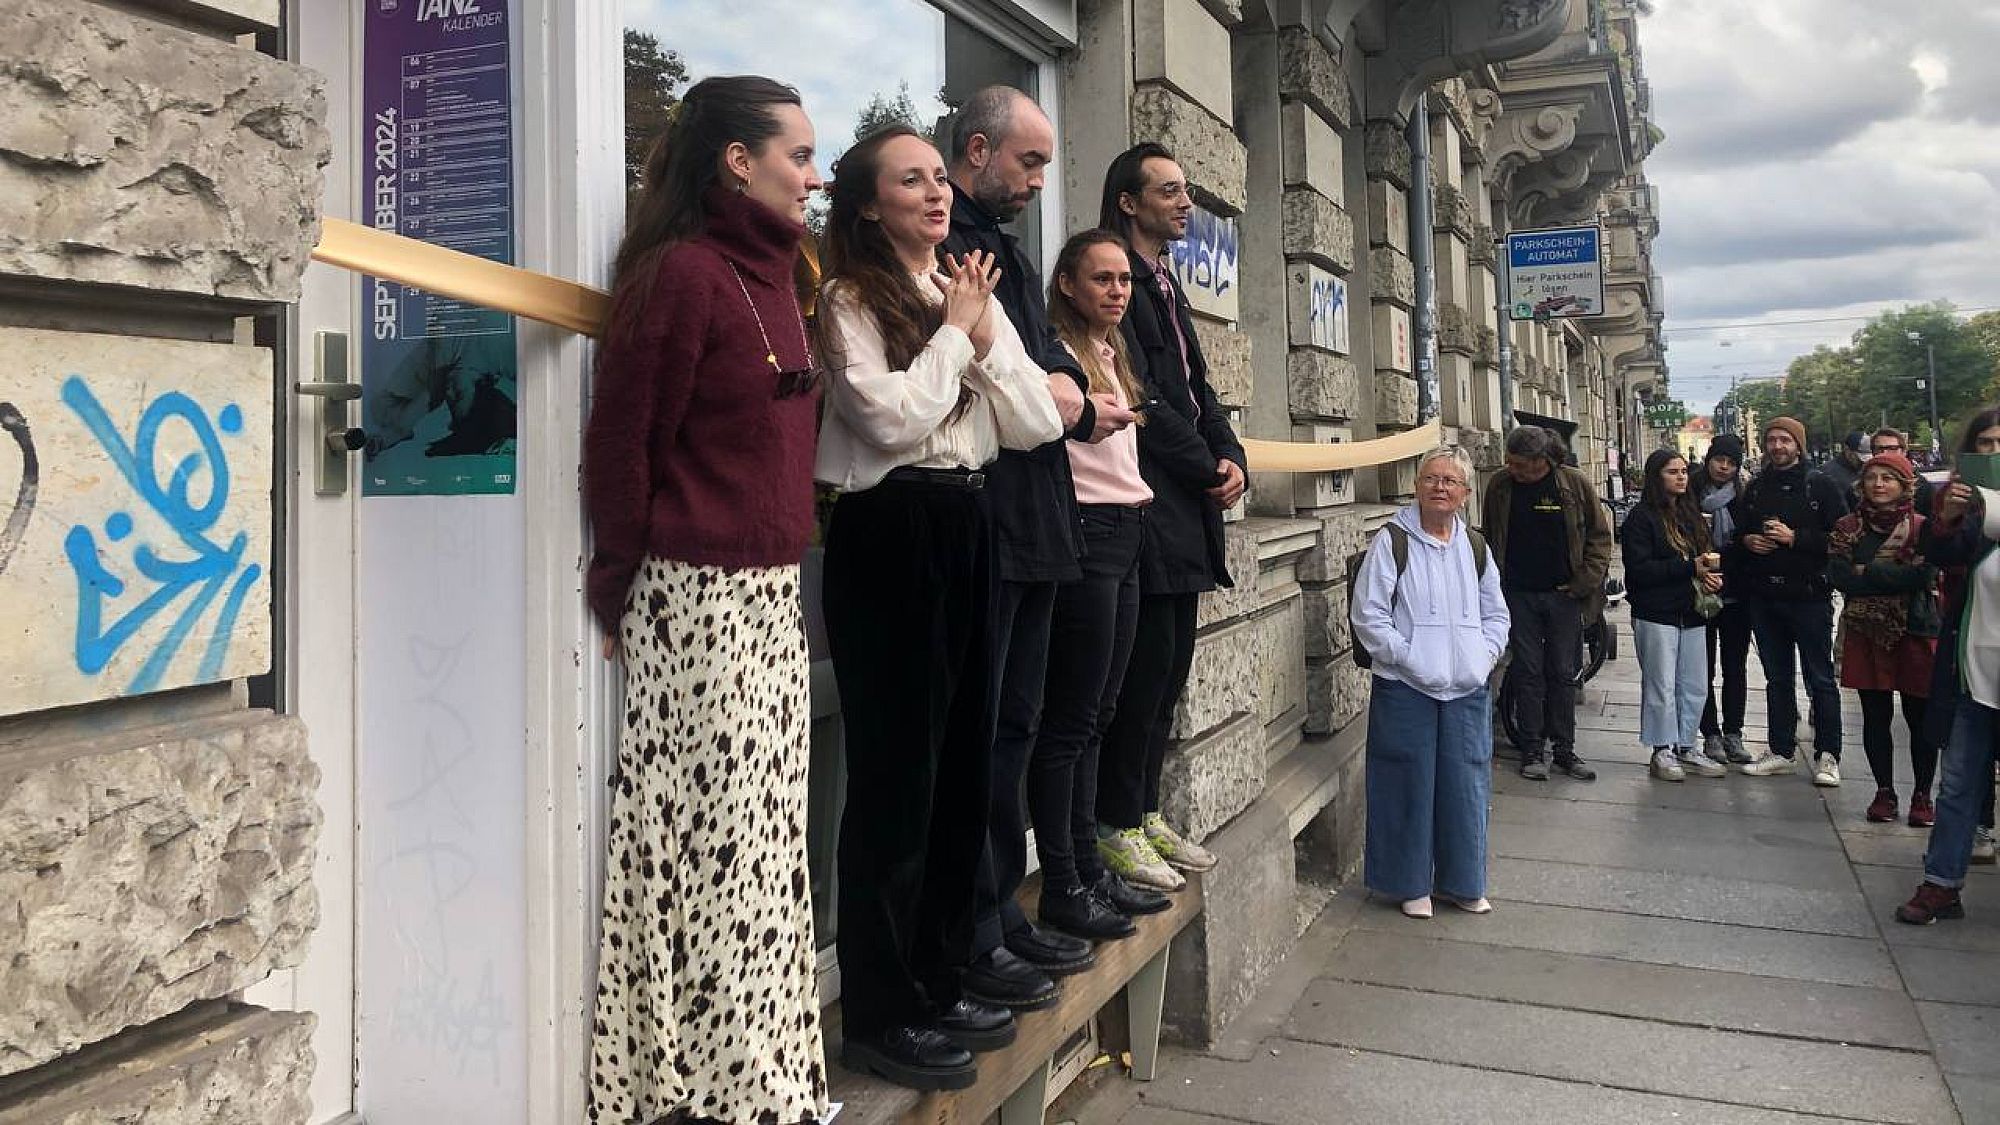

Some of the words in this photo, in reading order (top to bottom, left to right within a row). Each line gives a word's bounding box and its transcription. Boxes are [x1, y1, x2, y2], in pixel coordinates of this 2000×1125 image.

[443, 12, 502, 32] KALENDER
[375, 107, 397, 170] 2024
[1514, 236, 1592, 251] PARKSCHEIN-
[1527, 249, 1578, 262] AUTOMAT
[1517, 274, 1536, 283] Hier
[1540, 270, 1593, 282] Parkschein
[1541, 284, 1568, 293] lösen
